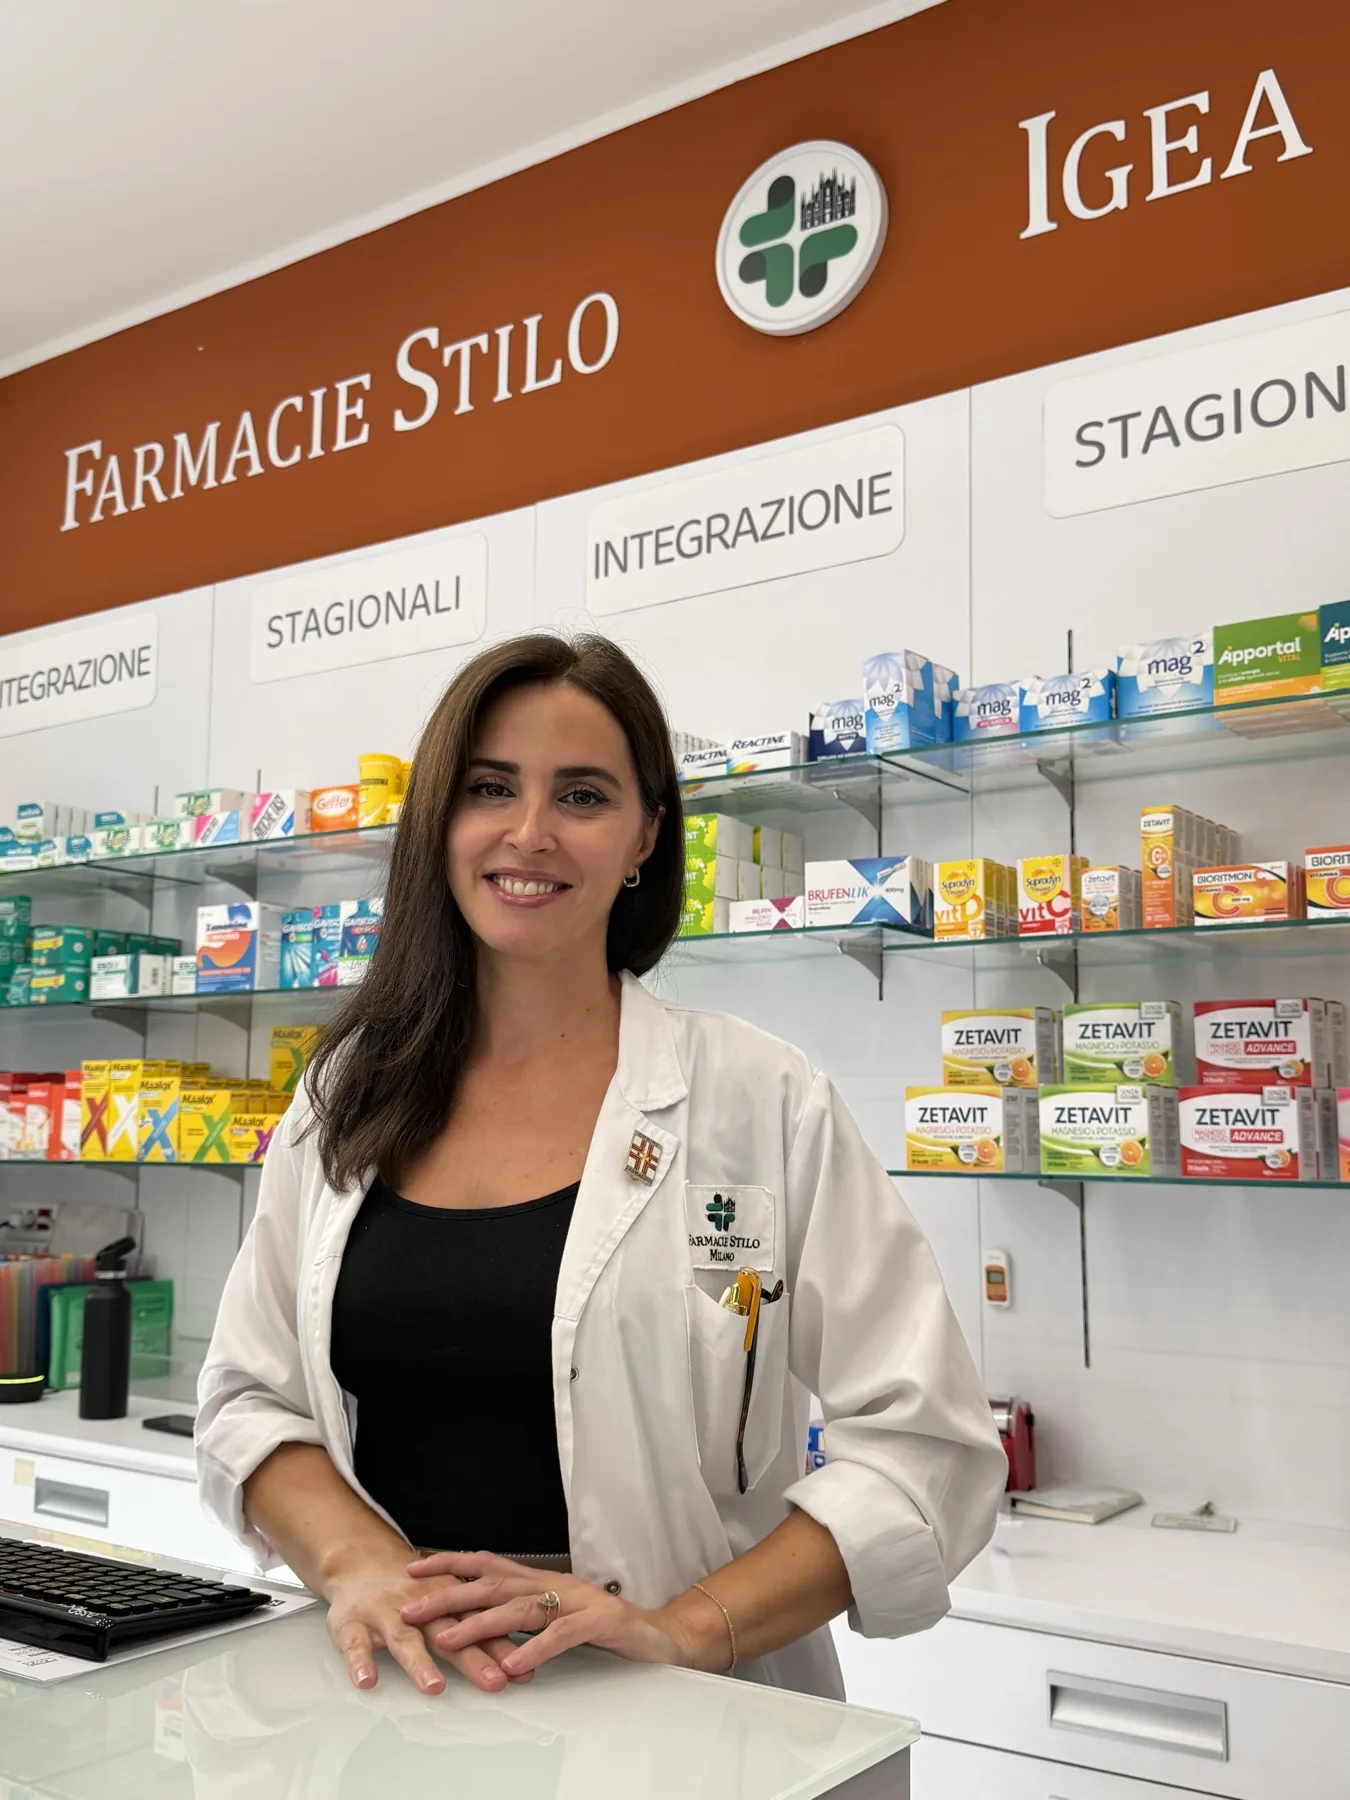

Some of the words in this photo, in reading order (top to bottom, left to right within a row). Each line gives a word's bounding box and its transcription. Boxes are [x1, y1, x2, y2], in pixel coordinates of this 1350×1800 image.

[1018, 68, 1314, 241] IGEA
[60, 372, 372, 532] FARMACIE
[394, 291, 621, 433] STILO
[1075, 364, 1347, 469] STAGION
[593, 471, 893, 579] INTEGRAZIONE
[266, 574, 462, 650] STAGIONALI
[1217, 637, 1302, 667] Apportal
[1147, 655, 1193, 675] mag
[868, 693, 895, 708] mag
[1045, 689, 1081, 706] mag
[976, 699, 1012, 717] mag
[831, 713, 865, 731] mag
[731, 734, 788, 750] REACTINE
[1143, 818, 1171, 828] ZETAVIT
[942, 878, 975, 890] Supradyn
[1026, 875, 1061, 887] Supradyn
[1197, 871, 1252, 885] BIORITMON
[807, 886, 869, 902] BRUFENLIK
[934, 905, 958, 922] vit
[1018, 902, 1045, 920] vit
[954, 1028, 1022, 1046] ZETAVIT
[1078, 1022, 1156, 1040] ZETAVIT
[1210, 1021, 1293, 1039] ZETAVIT
[1246, 1042, 1295, 1054] ADVANCE
[918, 1107, 988, 1123] ZETAVIT
[1054, 1107, 1132, 1124] ZETAVIT
[1195, 1108, 1280, 1126] ZETAVIT
[1232, 1131, 1283, 1142] ADVANCE
[729, 1235, 761, 1249] STILO
[710, 1248, 735, 1262] MILANO
